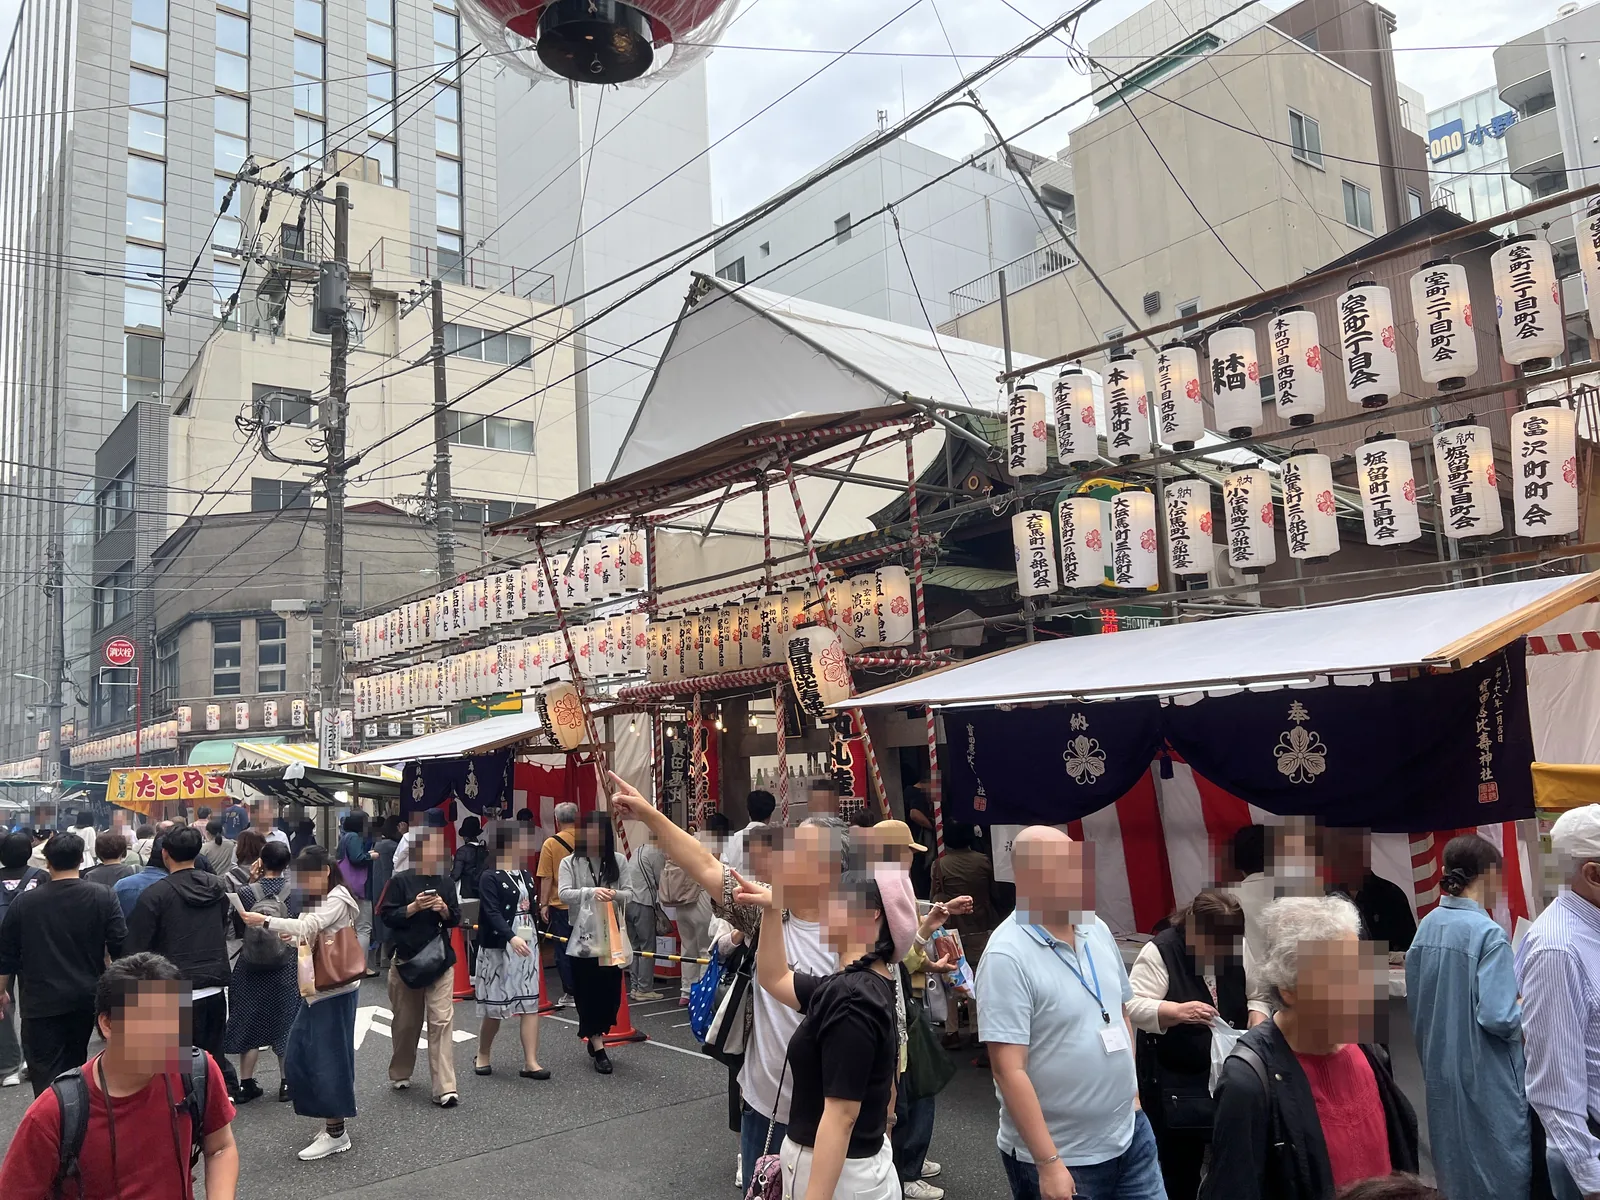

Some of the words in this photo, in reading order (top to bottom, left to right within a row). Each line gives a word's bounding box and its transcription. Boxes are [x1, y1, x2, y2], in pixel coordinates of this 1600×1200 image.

[1430, 131, 1463, 159] ono
[1424, 271, 1457, 361] 室町二丁目町会
[1508, 245, 1544, 340] 室町三丁目町会
[1225, 353, 1246, 391] 本四
[1274, 319, 1298, 406] 本町四丁目西町会
[1341, 294, 1381, 389] 室町一丁目会
[1009, 394, 1027, 469] 本町一丁目町会
[1107, 367, 1133, 448] 本三東町会
[1157, 354, 1179, 433] 本町三丁目西町会
[1226, 488, 1254, 562] 小伝馬町二の部町会
[1282, 463, 1310, 554] 小伝馬町三の部町会
[1363, 450, 1399, 540] 堀留町一丁目町会
[1026, 513, 1051, 588] 大伝馬町一の部町会
[1060, 502, 1079, 583] 大伝馬町二の部町会
[1113, 497, 1135, 584] 大伝馬町三の部町会
[1168, 500, 1194, 568] 小伝馬町一の部町会
[110, 647, 132, 658] 消火栓
[1069, 712, 1089, 732] 納
[1287, 701, 1311, 722] 奉
[135, 769, 226, 798] たこやき
